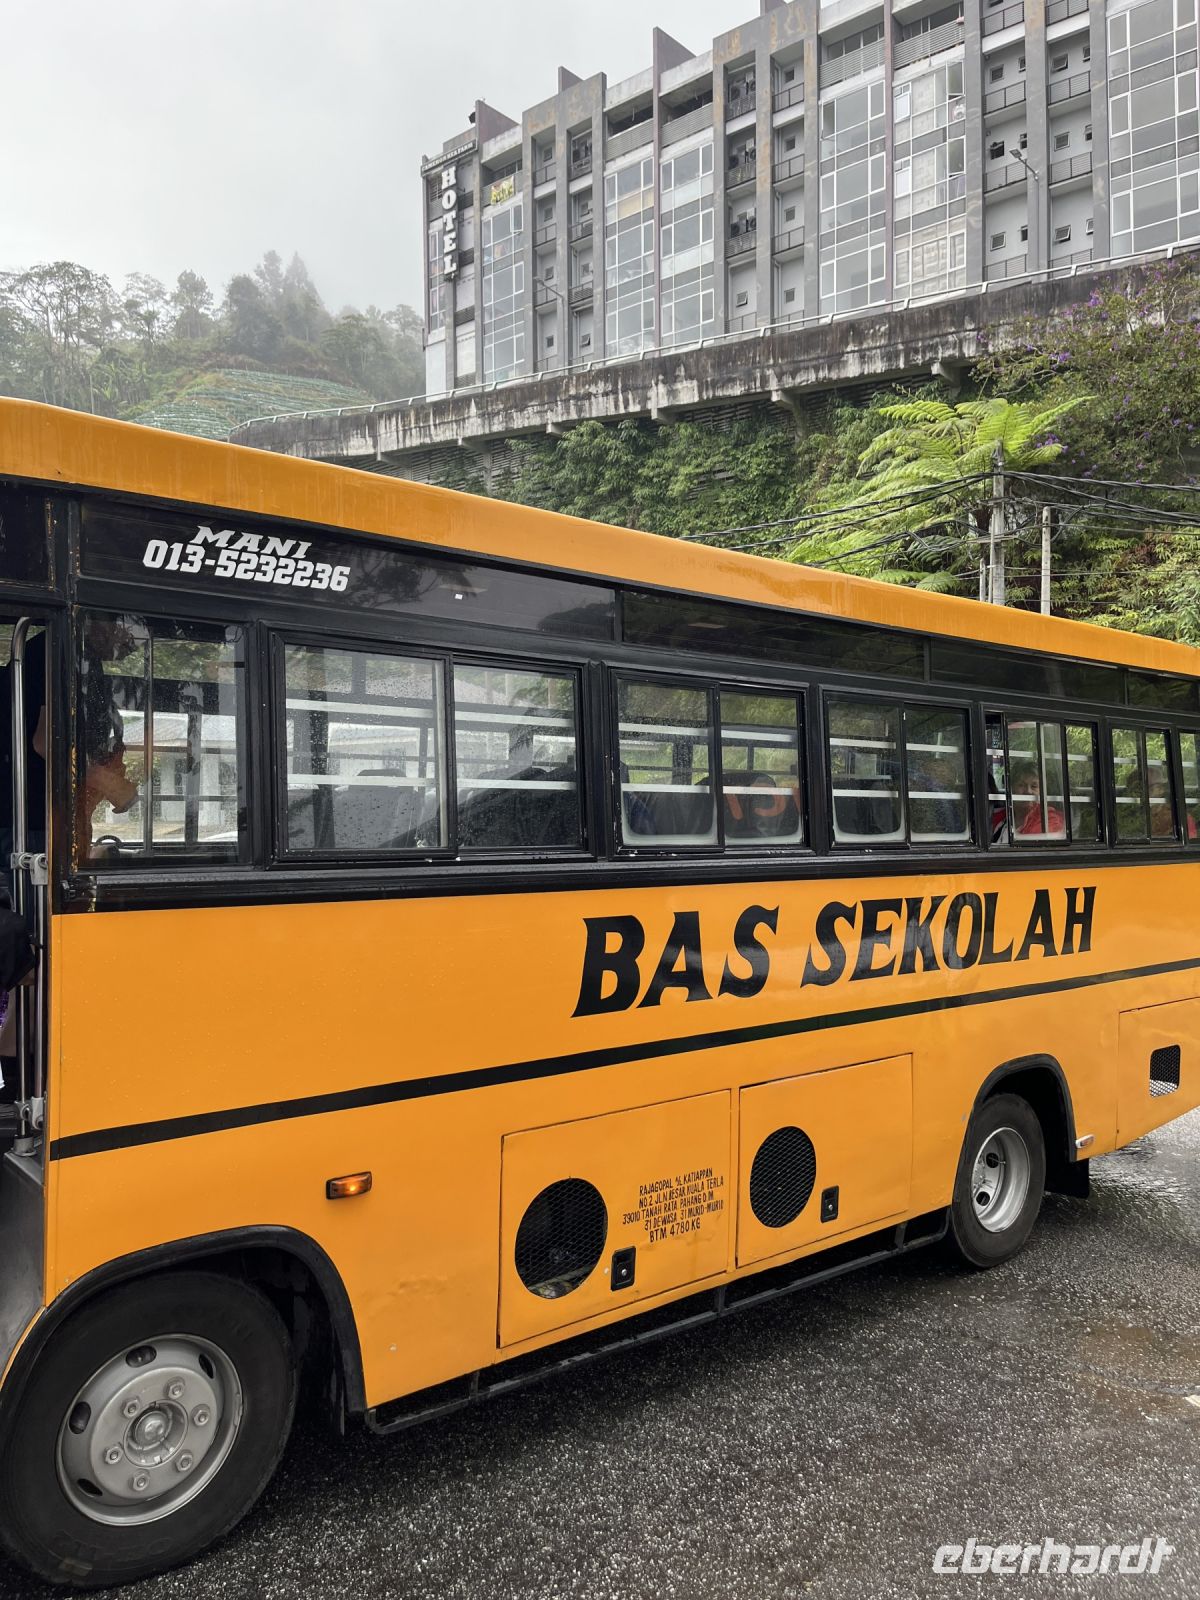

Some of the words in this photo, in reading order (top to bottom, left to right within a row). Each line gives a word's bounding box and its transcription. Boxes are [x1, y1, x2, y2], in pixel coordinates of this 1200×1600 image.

[441, 165, 458, 275] HOTEL
[189, 525, 313, 559] MANI
[142, 539, 351, 592] 013-5232236
[570, 904, 780, 1018] BAS
[800, 885, 1097, 989] SEKOLAH
[639, 1178, 674, 1197] RAJAGOPAL
[622, 1210, 641, 1225] 39010
[641, 1204, 662, 1220] TANAH
[663, 1199, 678, 1214] RATA
[680, 1193, 702, 1209] PAHANG
[652, 1211, 678, 1229] DEWASA
[649, 1226, 668, 1243] BTM
[669, 1219, 690, 1237] 4780
[691, 1216, 701, 1231] KG
